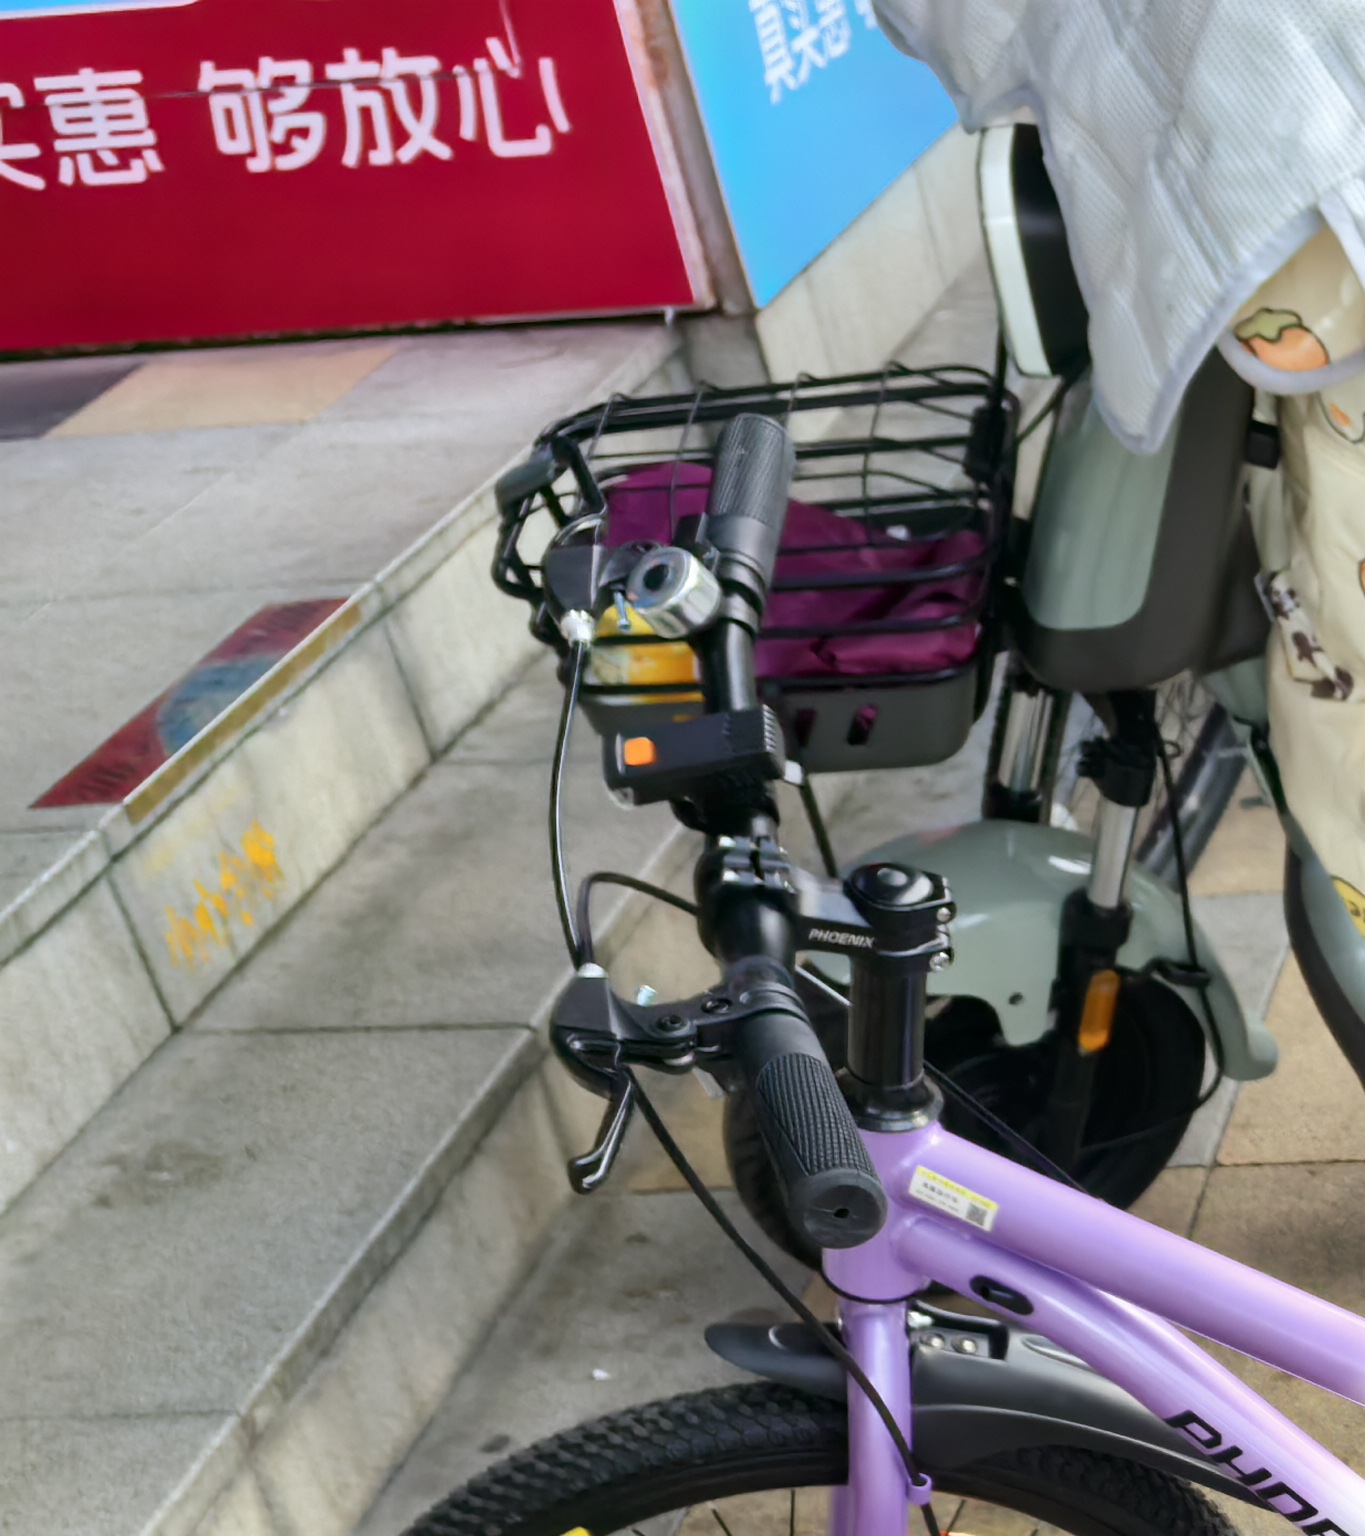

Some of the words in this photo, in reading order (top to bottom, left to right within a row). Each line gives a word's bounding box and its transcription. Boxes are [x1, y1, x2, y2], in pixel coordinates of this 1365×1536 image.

[198, 36, 570, 173] 够放心
[808, 928, 875, 948] PHOENIX
